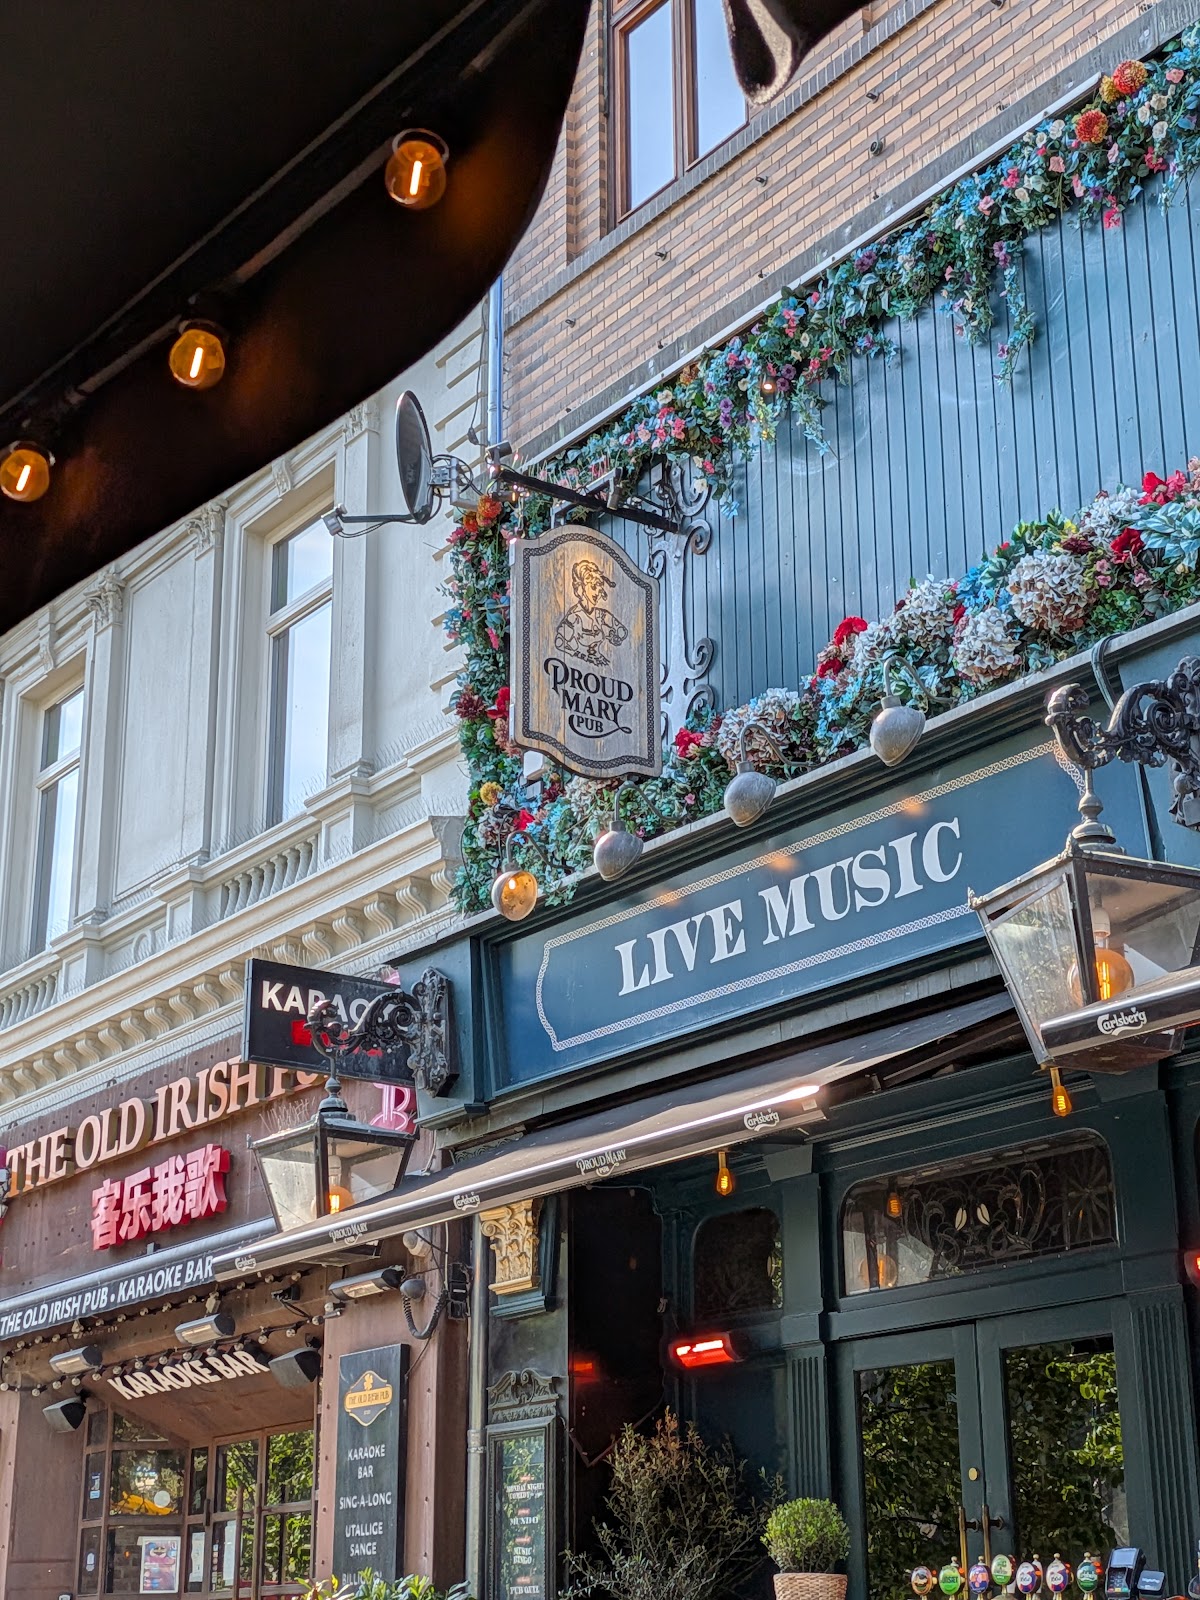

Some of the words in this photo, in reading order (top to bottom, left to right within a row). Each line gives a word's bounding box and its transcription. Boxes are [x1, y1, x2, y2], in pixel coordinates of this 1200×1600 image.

[544, 657, 633, 702] PROUD
[561, 688, 624, 724] MARY
[576, 715, 604, 733] PUB
[615, 899, 747, 996] LIVE
[758, 817, 963, 945] MUSIC
[1097, 1007, 1148, 1036] Carlsberg
[6, 1126, 69, 1198] THE
[75, 1097, 146, 1169] OLD
[153, 1055, 260, 1142] IRISH
[743, 1108, 780, 1132] Carlsberg
[91, 1143, 225, 1250] 客乐我歌
[453, 1192, 481, 1211] Carlsberg
[0, 1314, 22, 1336] THE
[22, 1305, 48, 1329] OLD
[50, 1297, 81, 1323] IRISH
[82, 1287, 109, 1315] PUB
[117, 1263, 183, 1304] KARAOKE
[185, 1254, 214, 1283] BAR
[107, 1360, 222, 1400] KARAOKE
[210, 1349, 271, 1380] BAR
[347, 1444, 386, 1461] KARAOKE
[357, 1465, 374, 1479] BAR
[339, 1491, 392, 1510] SING-A-LONG
[345, 1522, 383, 1538] UTALLIGE
[350, 1542, 377, 1557] SANGE
